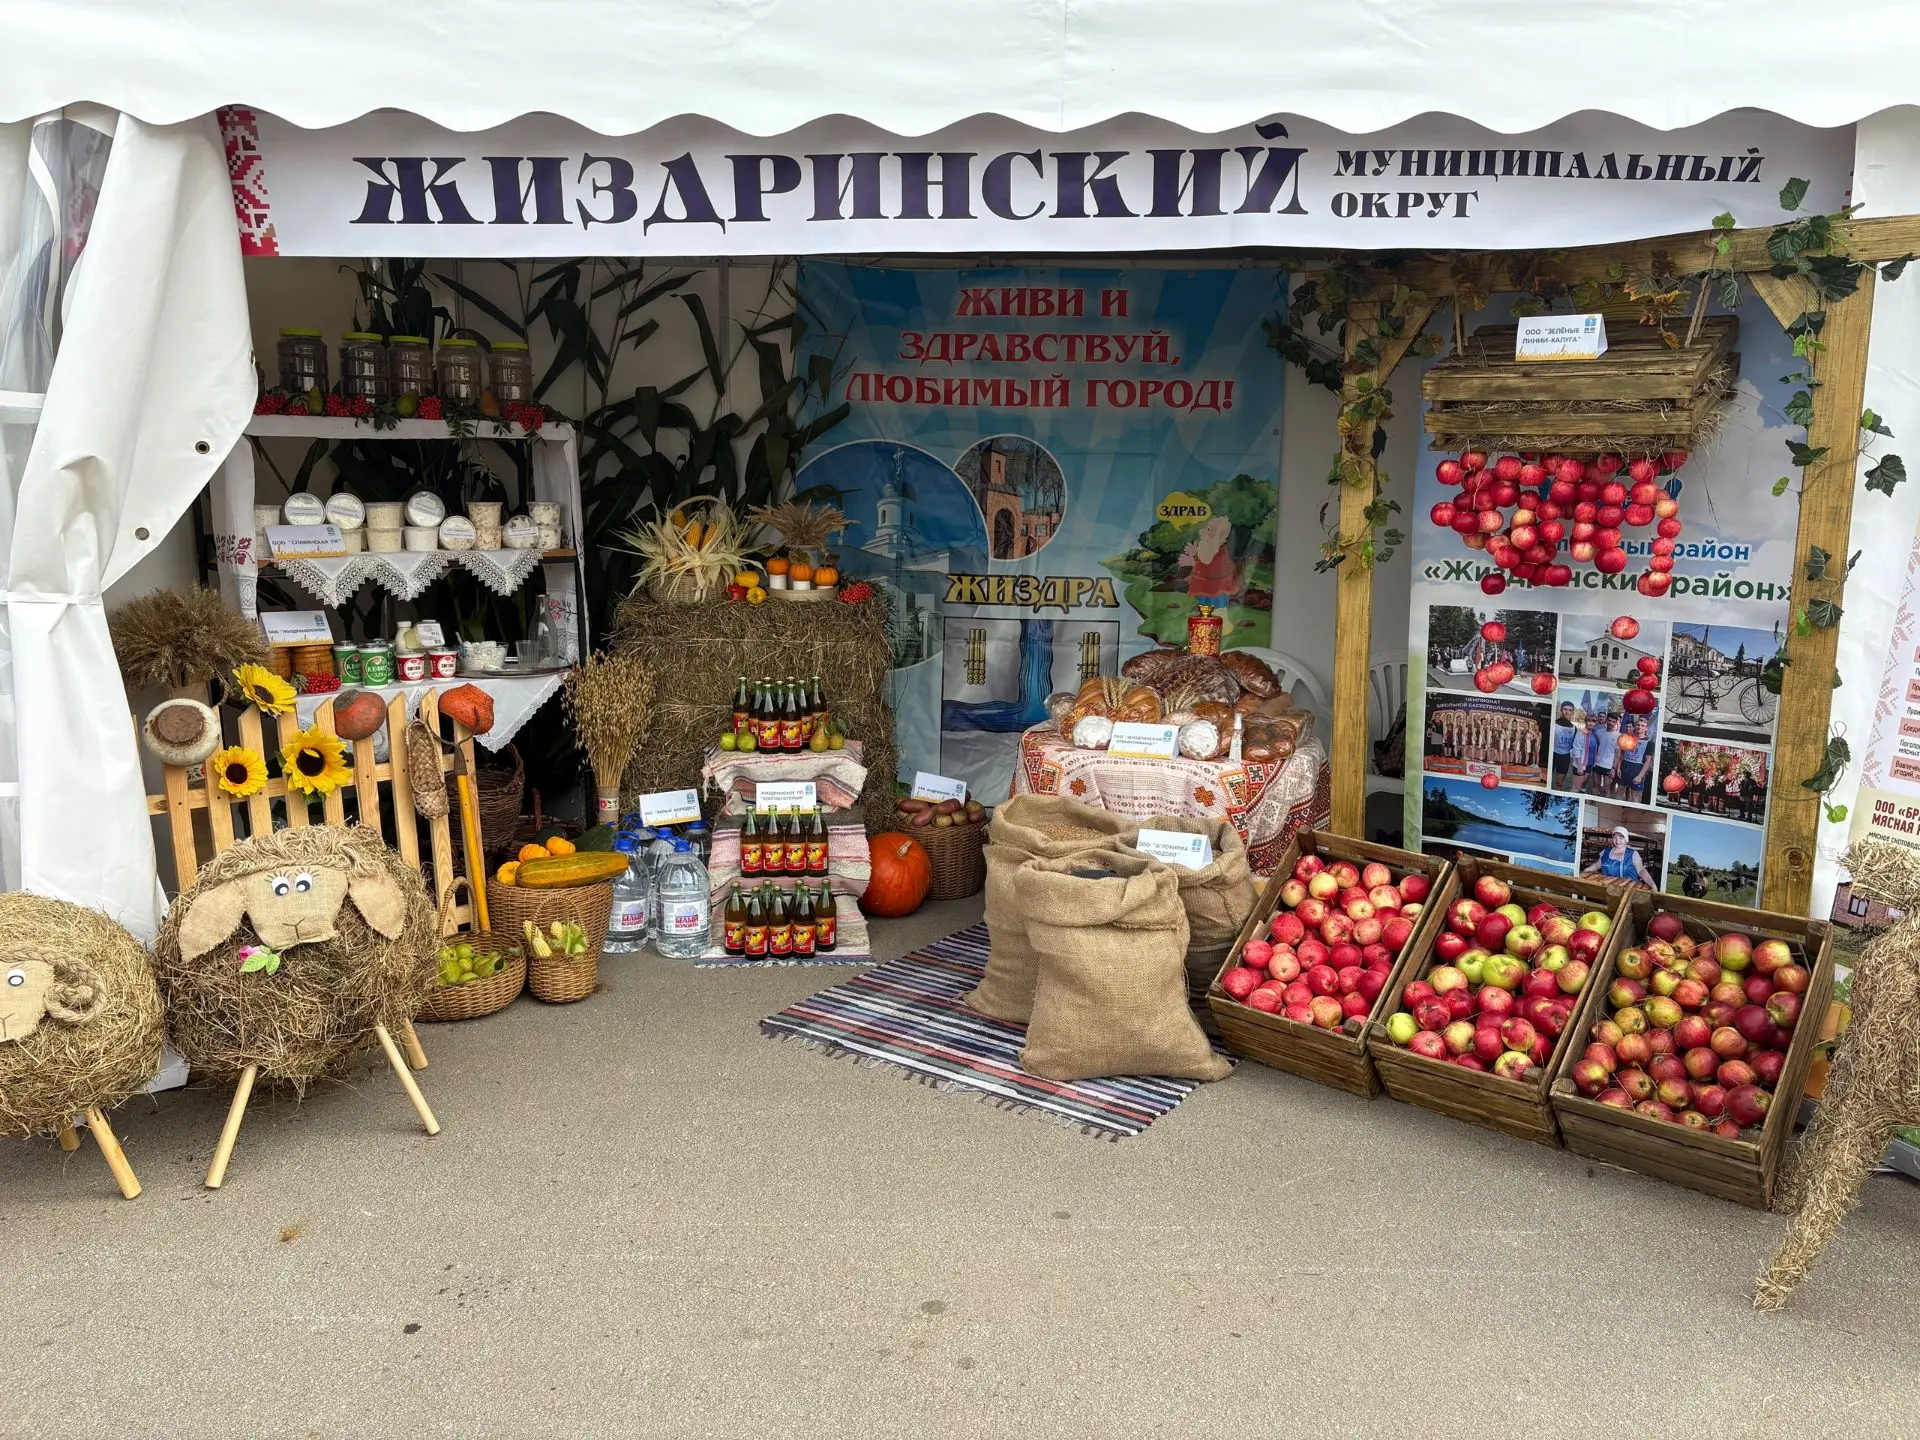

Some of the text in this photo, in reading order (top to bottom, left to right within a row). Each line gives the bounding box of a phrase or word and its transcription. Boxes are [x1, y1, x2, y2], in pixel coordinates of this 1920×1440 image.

[348, 122, 1309, 235] ЖИЗДРИНСКИЙ
[1333, 147, 1766, 183] МУНИЦИПАЛЬНЫЙ
[1331, 190, 1479, 218] ОКРУГ
[955, 287, 1128, 317] ЖИВИ И
[900, 329, 1181, 367] ЗДРАВСТВУЙ,
[845, 372, 1234, 416] ЛЮБИМЫЙ ГОРОД!
[1160, 505, 1208, 518] ЗДРАВ
[1672, 539, 1749, 560] район
[943, 573, 1120, 614] ЖИЗДРА
[1871, 812, 1914, 834] МЯСНАЯ
[1875, 799, 1920, 821] ООО «БР
